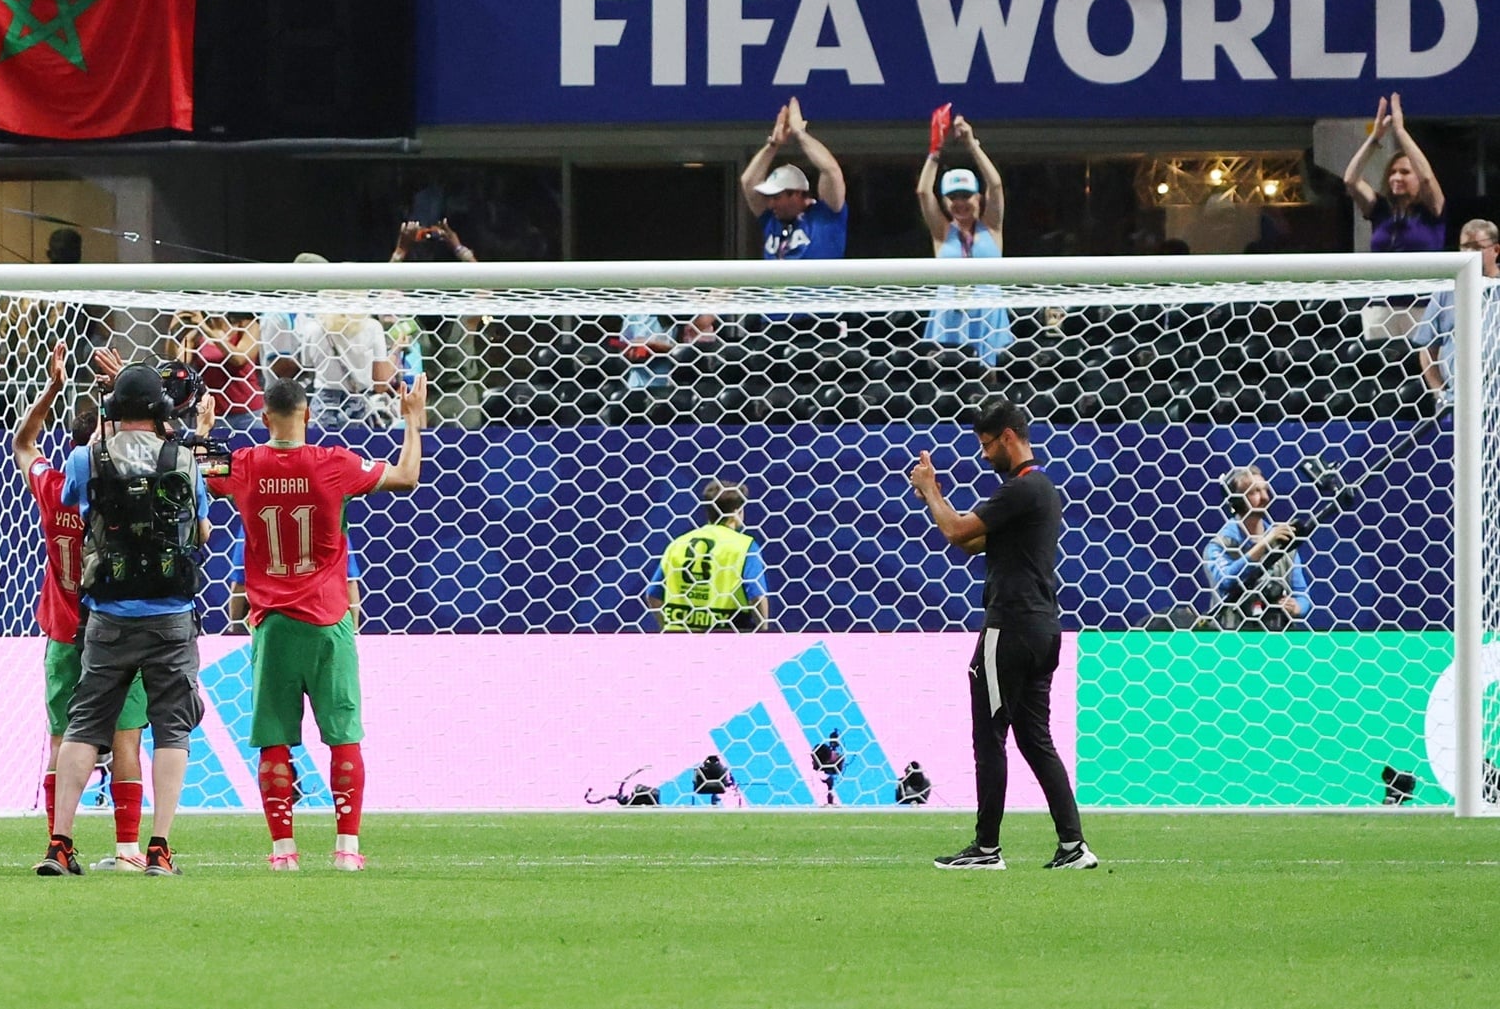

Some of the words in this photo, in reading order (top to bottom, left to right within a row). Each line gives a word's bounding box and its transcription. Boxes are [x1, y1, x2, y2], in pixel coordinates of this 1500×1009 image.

[764, 228, 811, 255] UA
[258, 477, 309, 494] SAIBARI
[257, 504, 318, 578] 11
